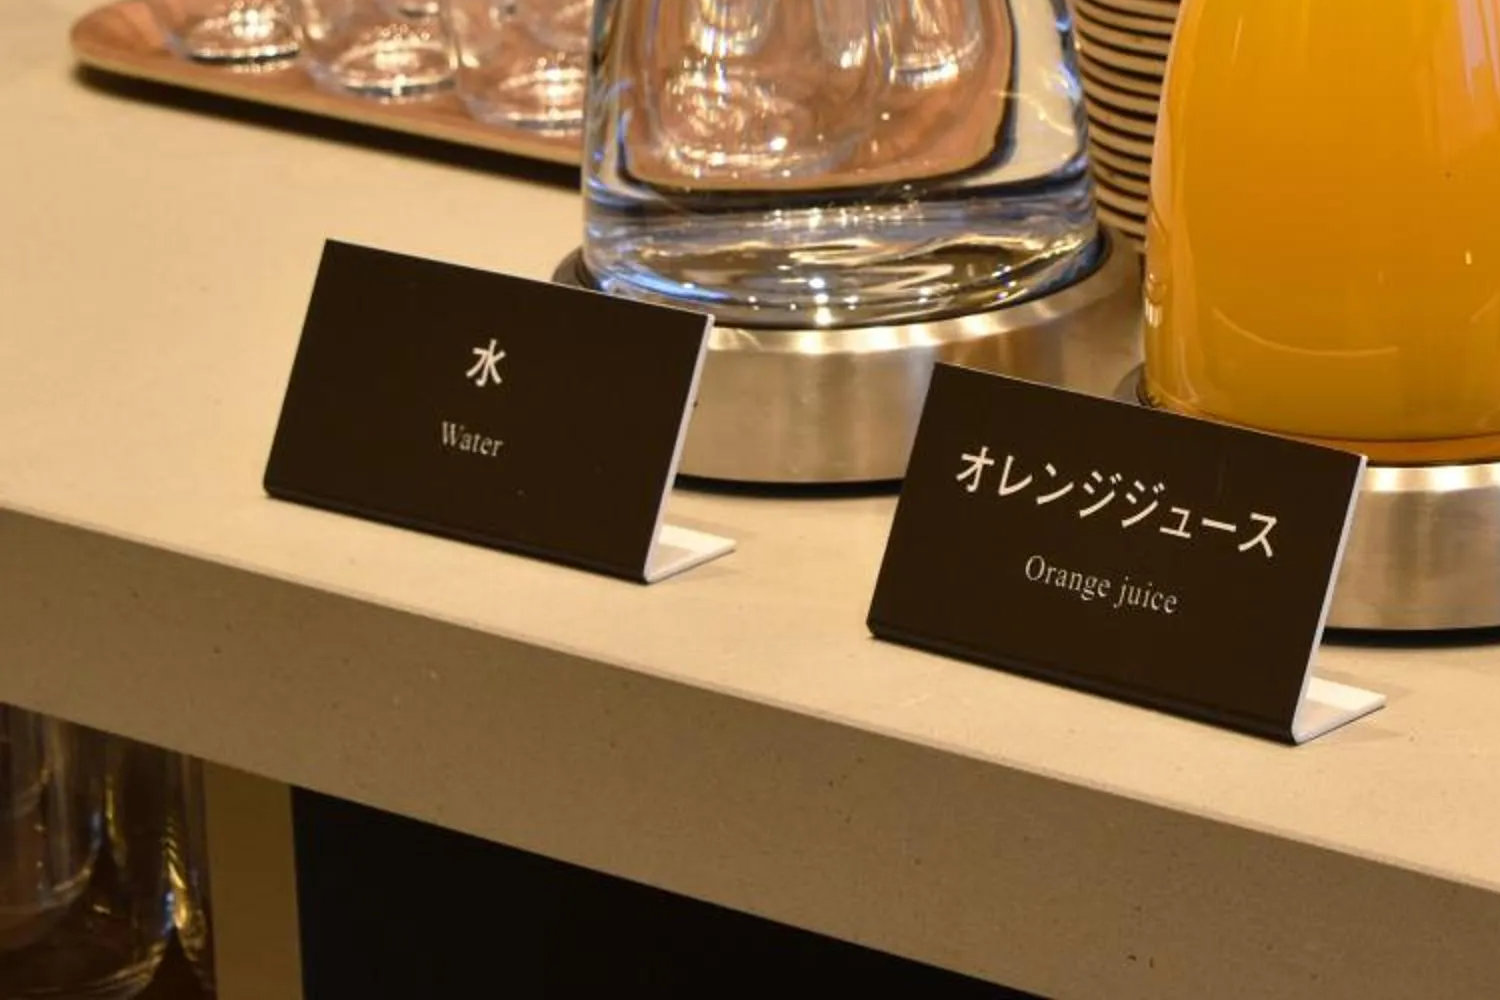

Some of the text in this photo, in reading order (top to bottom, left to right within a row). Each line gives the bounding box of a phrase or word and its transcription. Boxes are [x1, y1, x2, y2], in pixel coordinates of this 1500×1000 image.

[465, 337, 507, 388] 水
[441, 420, 504, 457] Water
[955, 445, 1278, 559] オレンジジュース
[1024, 554, 1178, 615] Orange juice
